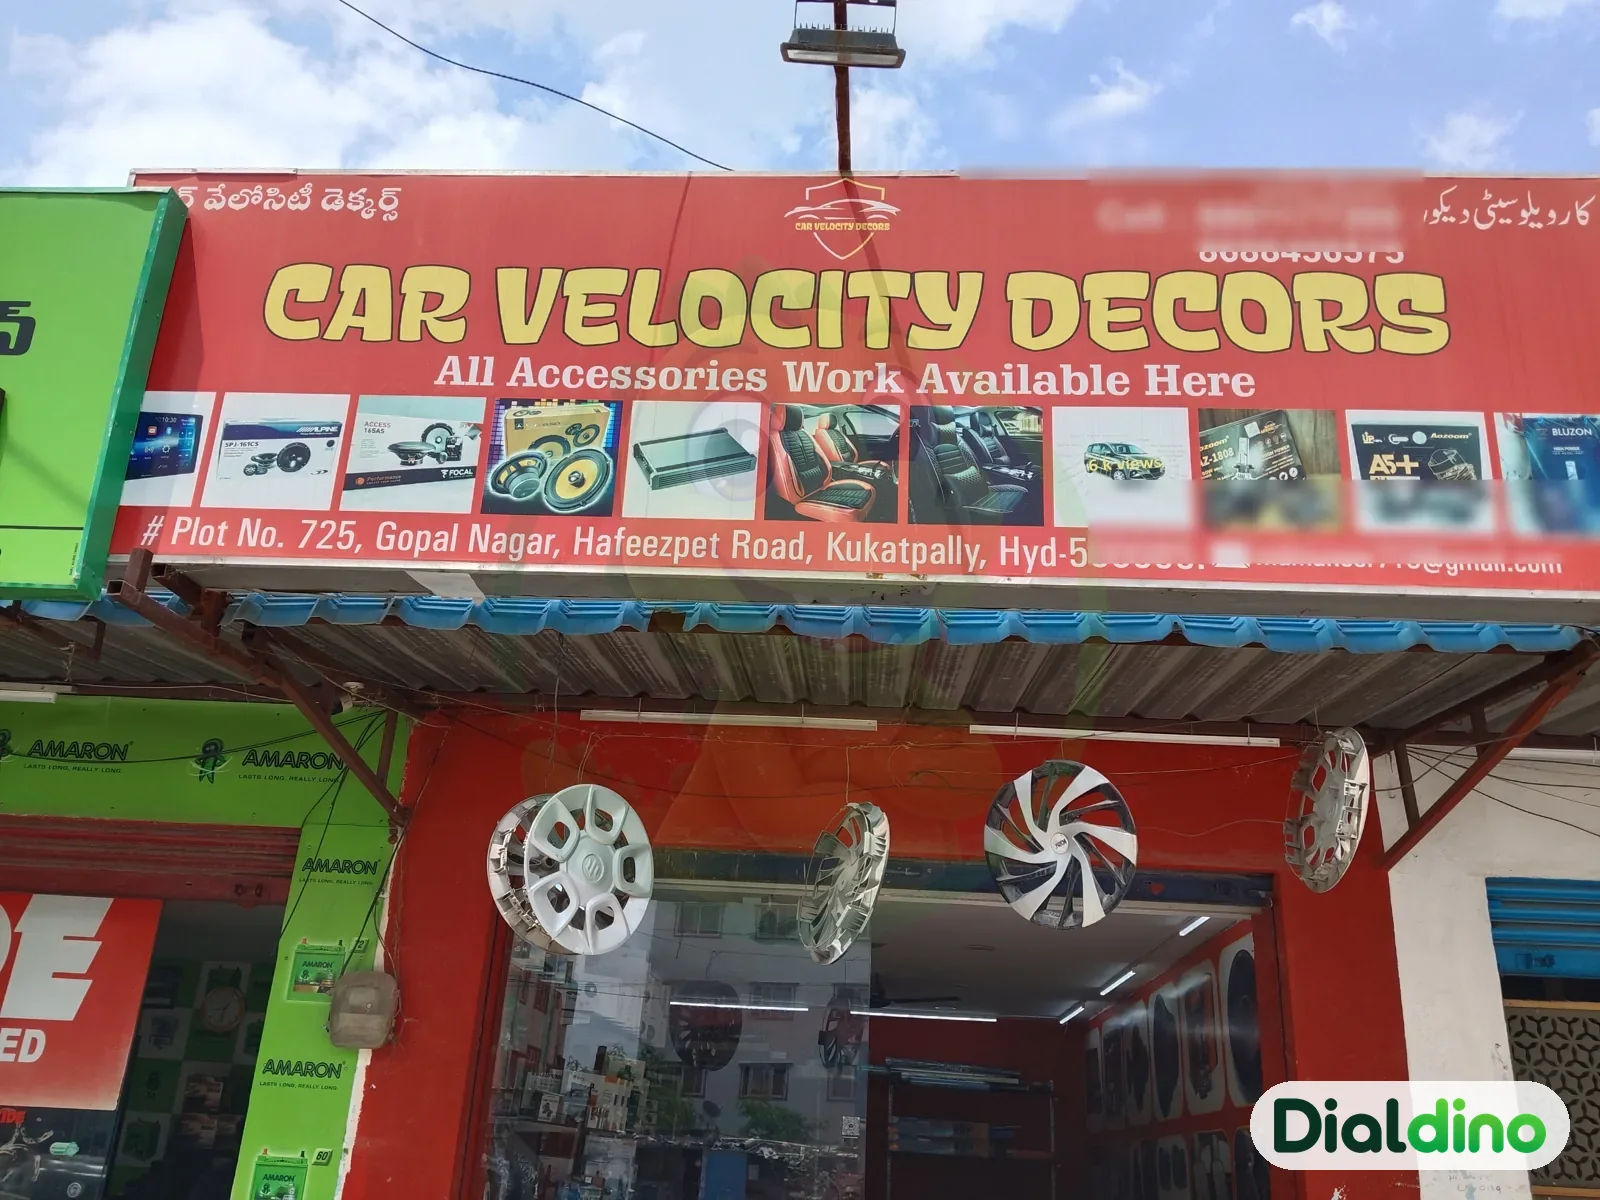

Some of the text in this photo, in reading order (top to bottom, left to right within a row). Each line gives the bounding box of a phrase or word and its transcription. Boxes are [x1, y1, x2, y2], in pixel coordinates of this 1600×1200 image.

[203, 182, 313, 211] వేలోసిటీ
[795, 222, 891, 231] CAR VELOCITY DECORS
[263, 262, 1452, 355] CAR VELOCITY DECORS
[434, 355, 1256, 397] All Accessories Work Available Here
[364, 421, 391, 429] ACCESS
[1551, 427, 1593, 437] BLUZON
[1430, 432, 1469, 440] Aozoom
[1368, 453, 1420, 475] A5+
[366, 474, 402, 482] Performance
[448, 468, 474, 476] FOCAL
[140, 515, 164, 546] #
[170, 516, 229, 547] Plot
[237, 518, 284, 548] No.
[298, 520, 362, 554] 725,
[376, 521, 459, 558] Gopal
[468, 523, 561, 561] Nagar,
[574, 526, 720, 565] Hafeezpet
[731, 529, 813, 564] Road,
[827, 531, 987, 572] Kukatpally,
[27, 739, 130, 761] AMARON
[242, 748, 344, 770] AMARON
[302, 857, 379, 876] AMARON
[301, 960, 333, 969] AMARON
[262, 1058, 343, 1080] AMARON
[316, 1150, 329, 1161] 60
[262, 1173, 295, 1183] AMARON
